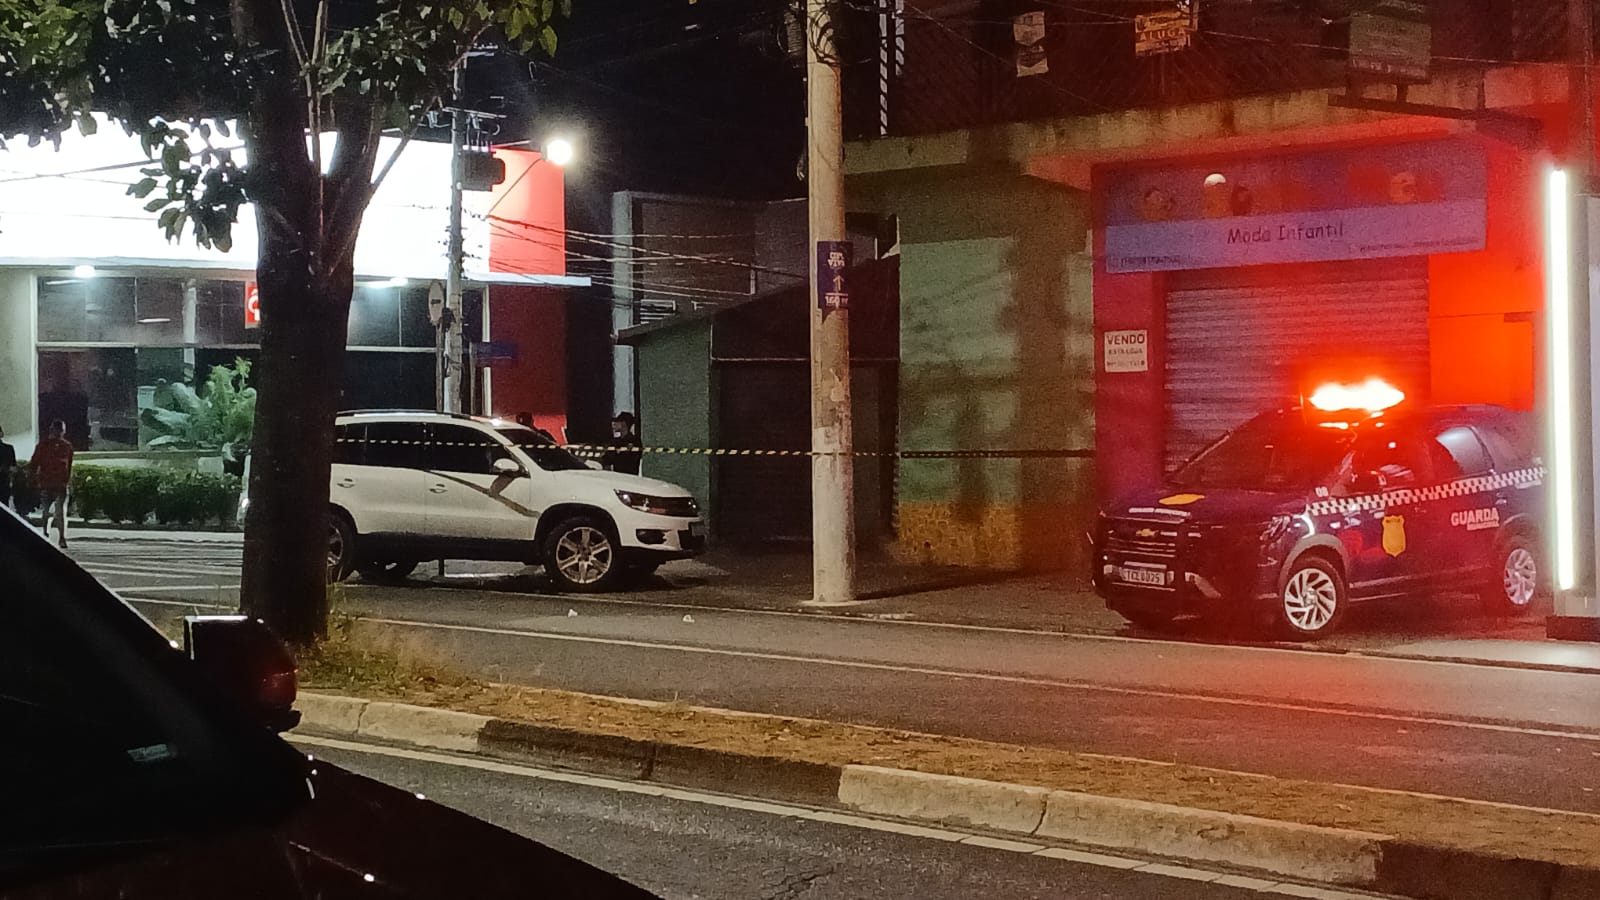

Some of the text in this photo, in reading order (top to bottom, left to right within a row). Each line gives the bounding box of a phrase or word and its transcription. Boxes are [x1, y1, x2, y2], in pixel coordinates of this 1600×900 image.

[1138, 27, 1186, 41] ALUGA
[1226, 219, 1343, 244] Moda Infantil
[1106, 333, 1145, 345] VENDO
[1450, 507, 1499, 526] GUARDA
